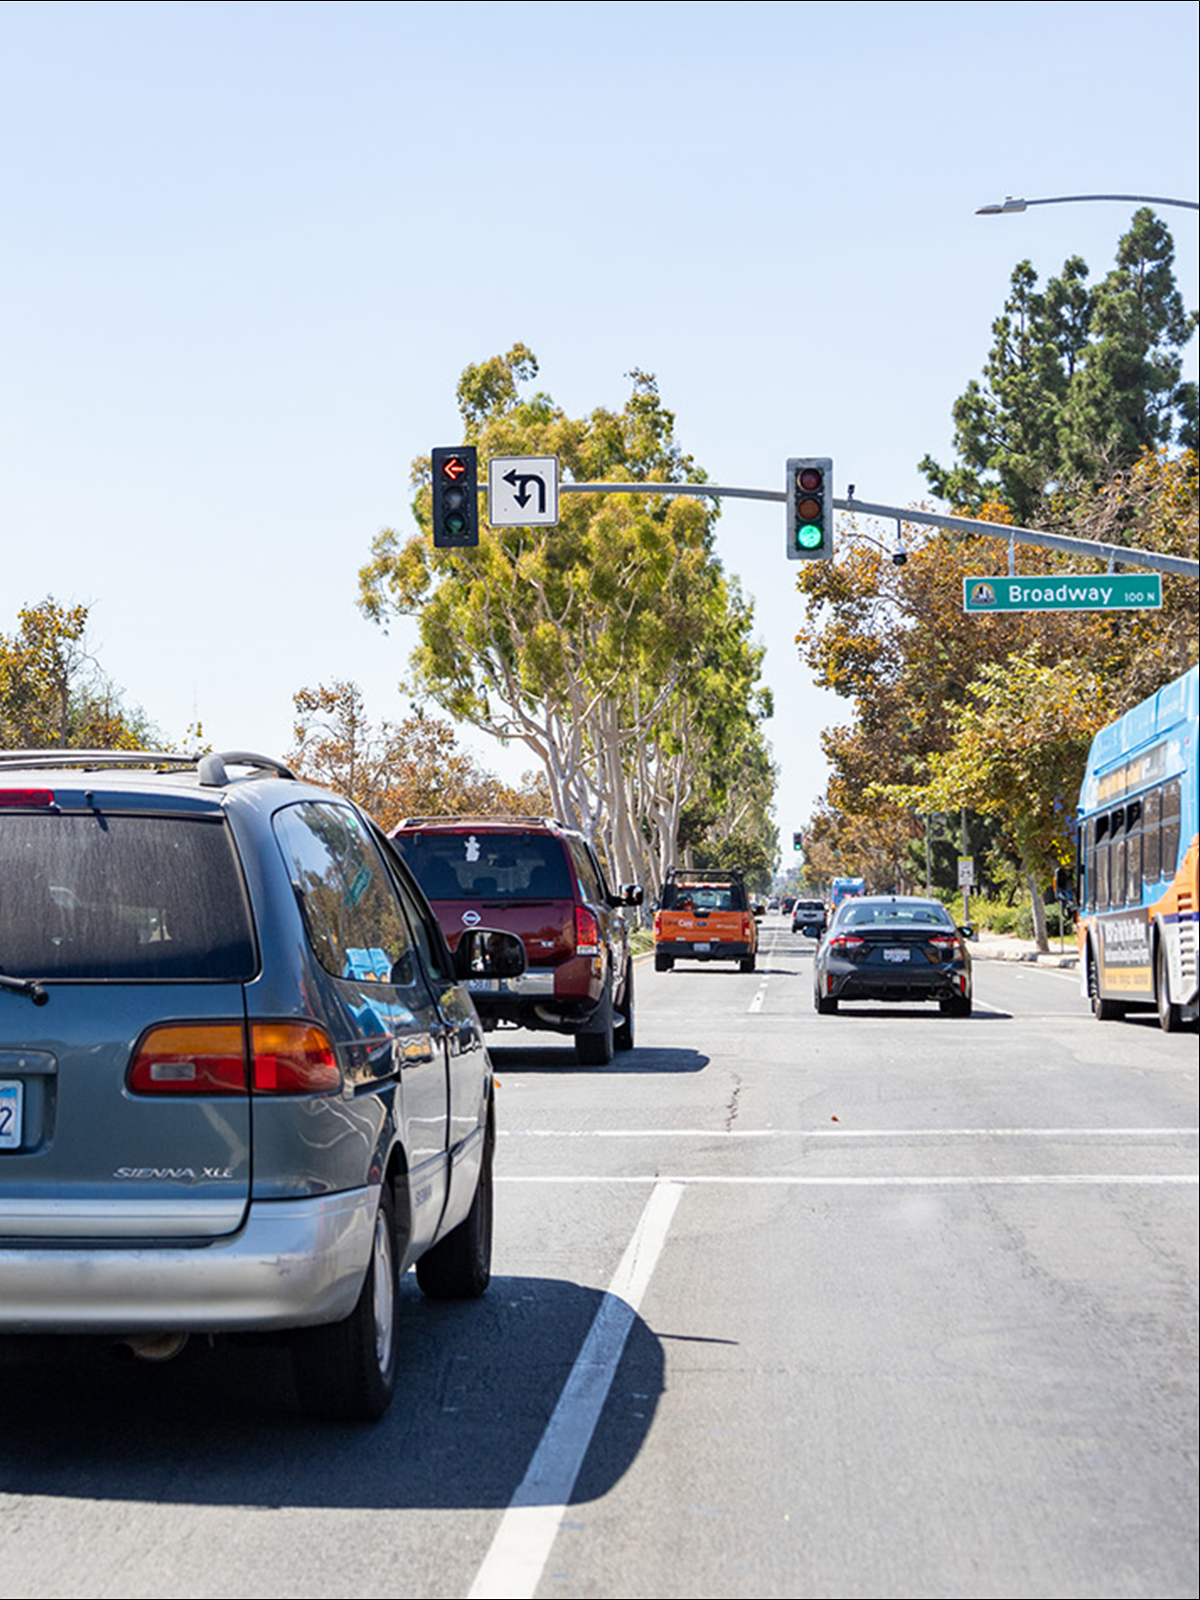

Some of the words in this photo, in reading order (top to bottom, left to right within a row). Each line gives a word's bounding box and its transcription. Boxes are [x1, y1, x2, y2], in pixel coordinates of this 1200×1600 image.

[1008, 584, 1114, 605] Broadway
[1124, 591, 1145, 603] 100
[1146, 591, 1156, 602] N
[112, 1166, 197, 1179] SIENNA
[201, 1167, 234, 1179] XLE
